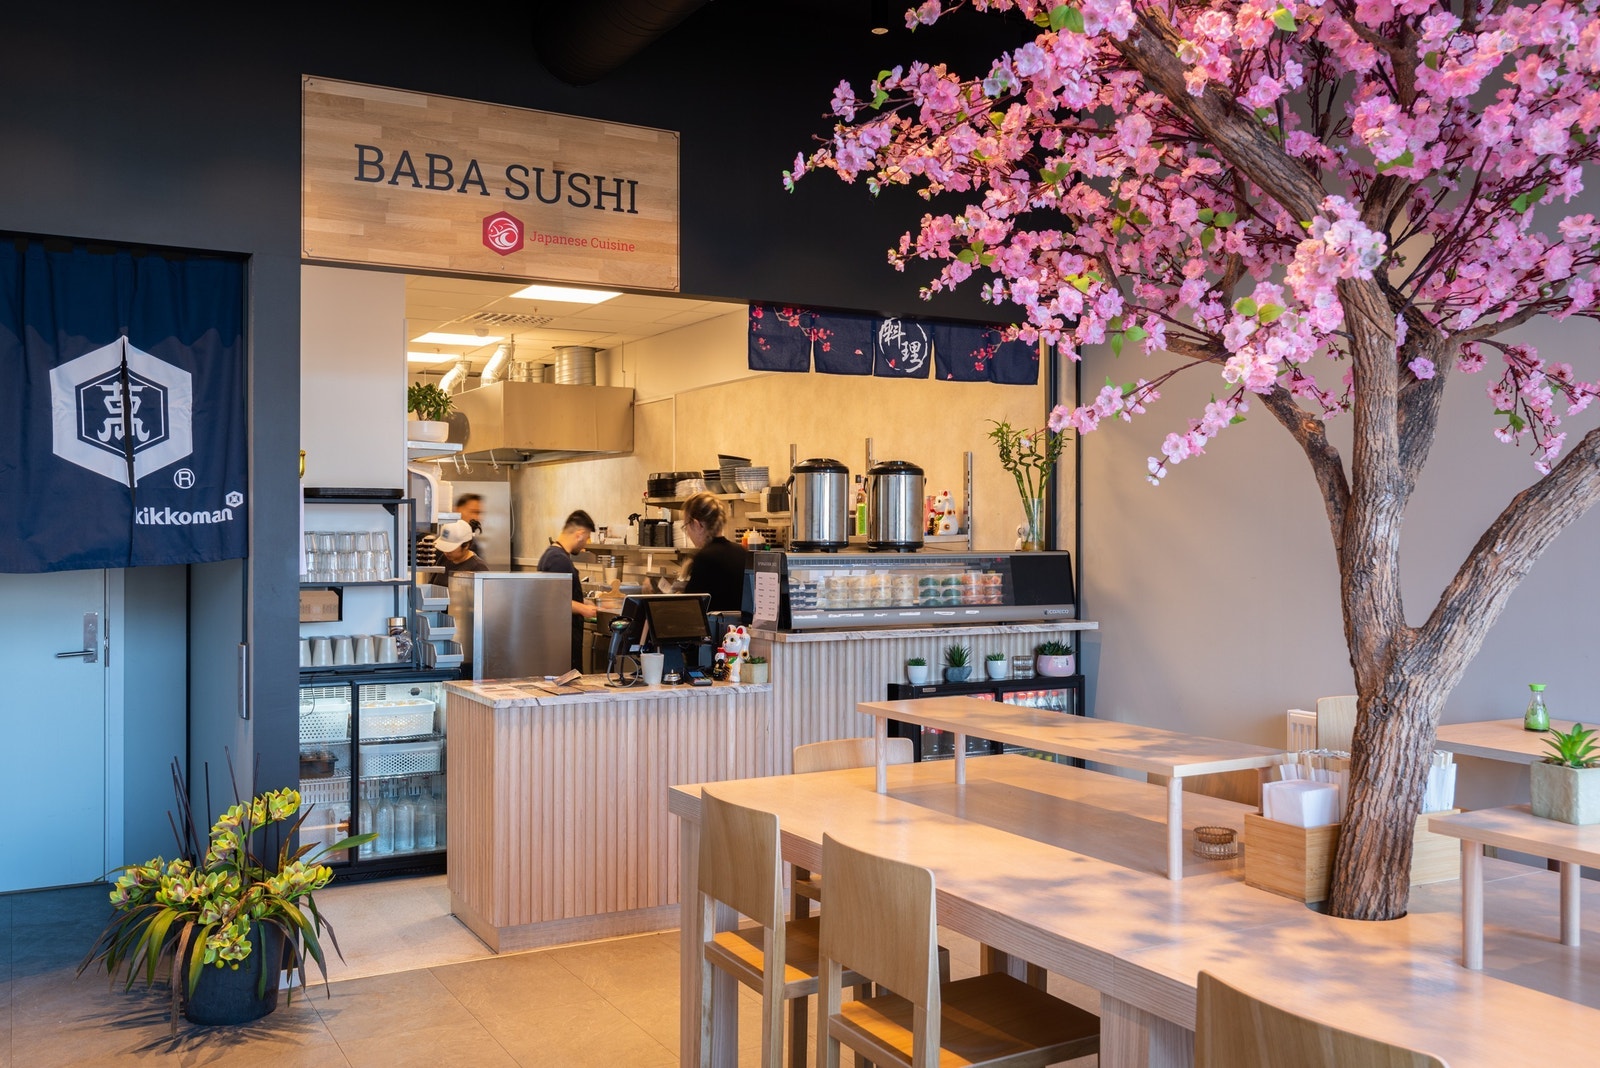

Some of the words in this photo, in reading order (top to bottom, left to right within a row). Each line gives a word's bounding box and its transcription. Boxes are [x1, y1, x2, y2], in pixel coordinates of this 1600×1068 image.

[354, 144, 490, 196] BABA
[505, 164, 639, 214] SUSHI
[529, 231, 588, 247] Japanese
[590, 237, 636, 252] Cuisine
[135, 506, 233, 526] kikkoman
